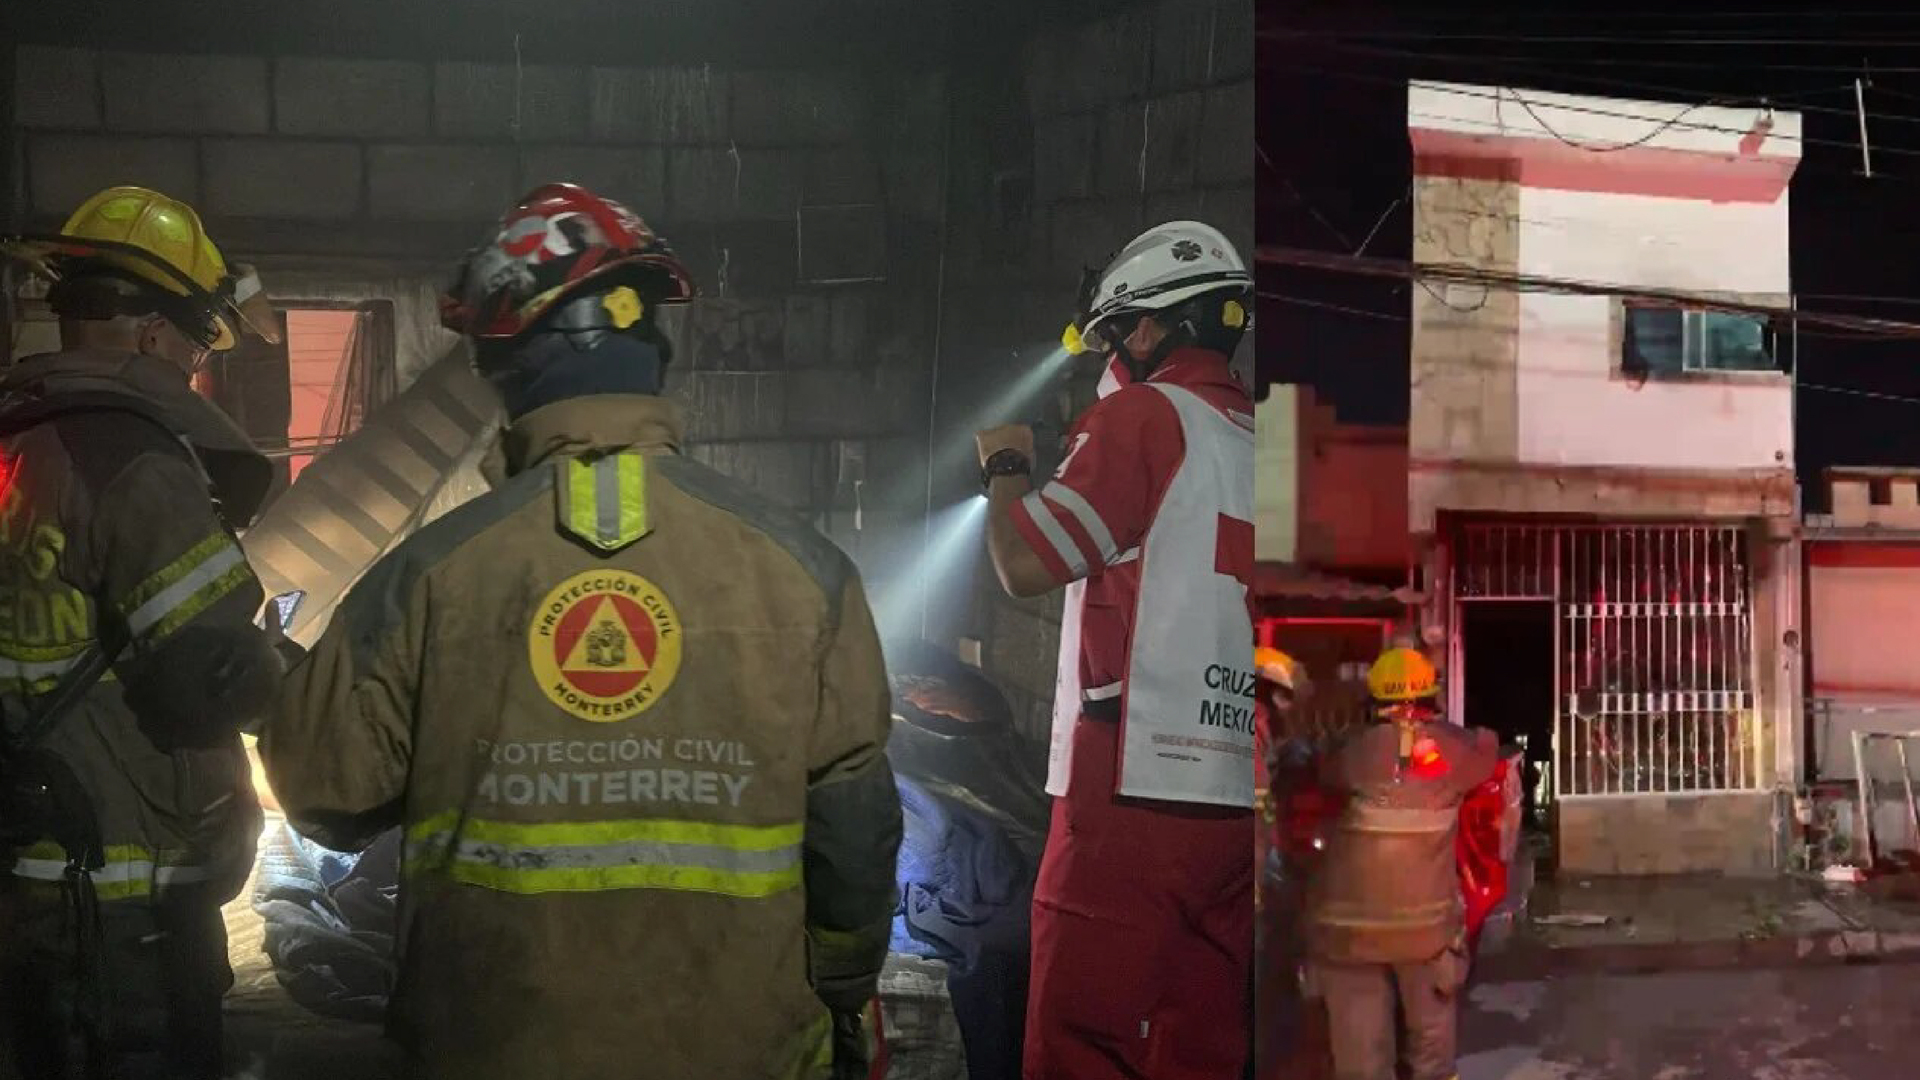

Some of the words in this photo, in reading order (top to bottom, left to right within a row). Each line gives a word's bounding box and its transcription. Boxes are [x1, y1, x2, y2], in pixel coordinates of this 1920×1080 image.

[539, 577, 641, 636] PROTECCIÓN
[643, 595, 674, 638] CIVIL
[554, 683, 654, 716] MONTERREY
[674, 738, 755, 766] CIVIL
